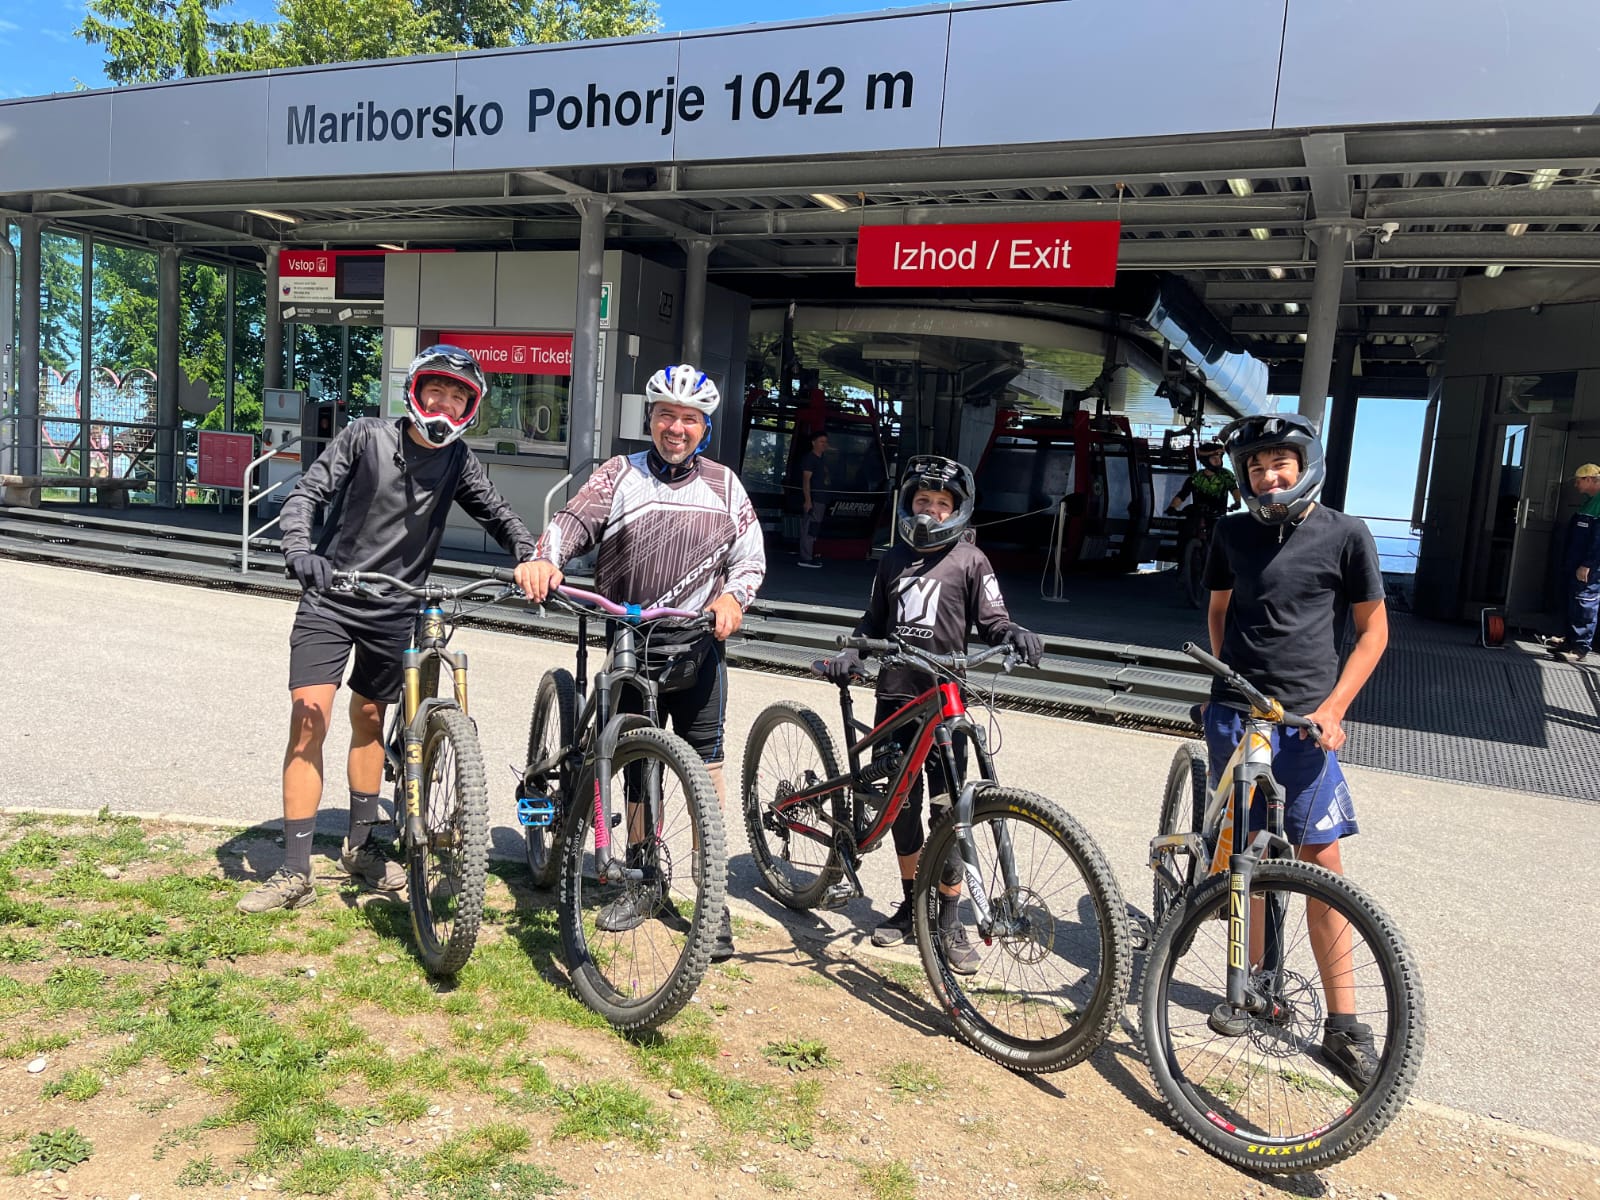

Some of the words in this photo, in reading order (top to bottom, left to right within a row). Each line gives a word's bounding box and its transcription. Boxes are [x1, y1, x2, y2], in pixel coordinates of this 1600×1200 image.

[286, 93, 504, 146] Mariborsko
[527, 76, 705, 137] Pohorje
[724, 66, 846, 122] 1042
[865, 70, 914, 110] m
[288, 258, 315, 273] Vstop
[893, 240, 977, 271] Izhod
[1008, 238, 1072, 270] Exit
[464, 345, 508, 362] ovnice
[560, 836, 572, 904] MAXXIS
[1247, 1138, 1322, 1157] MAXXIS
